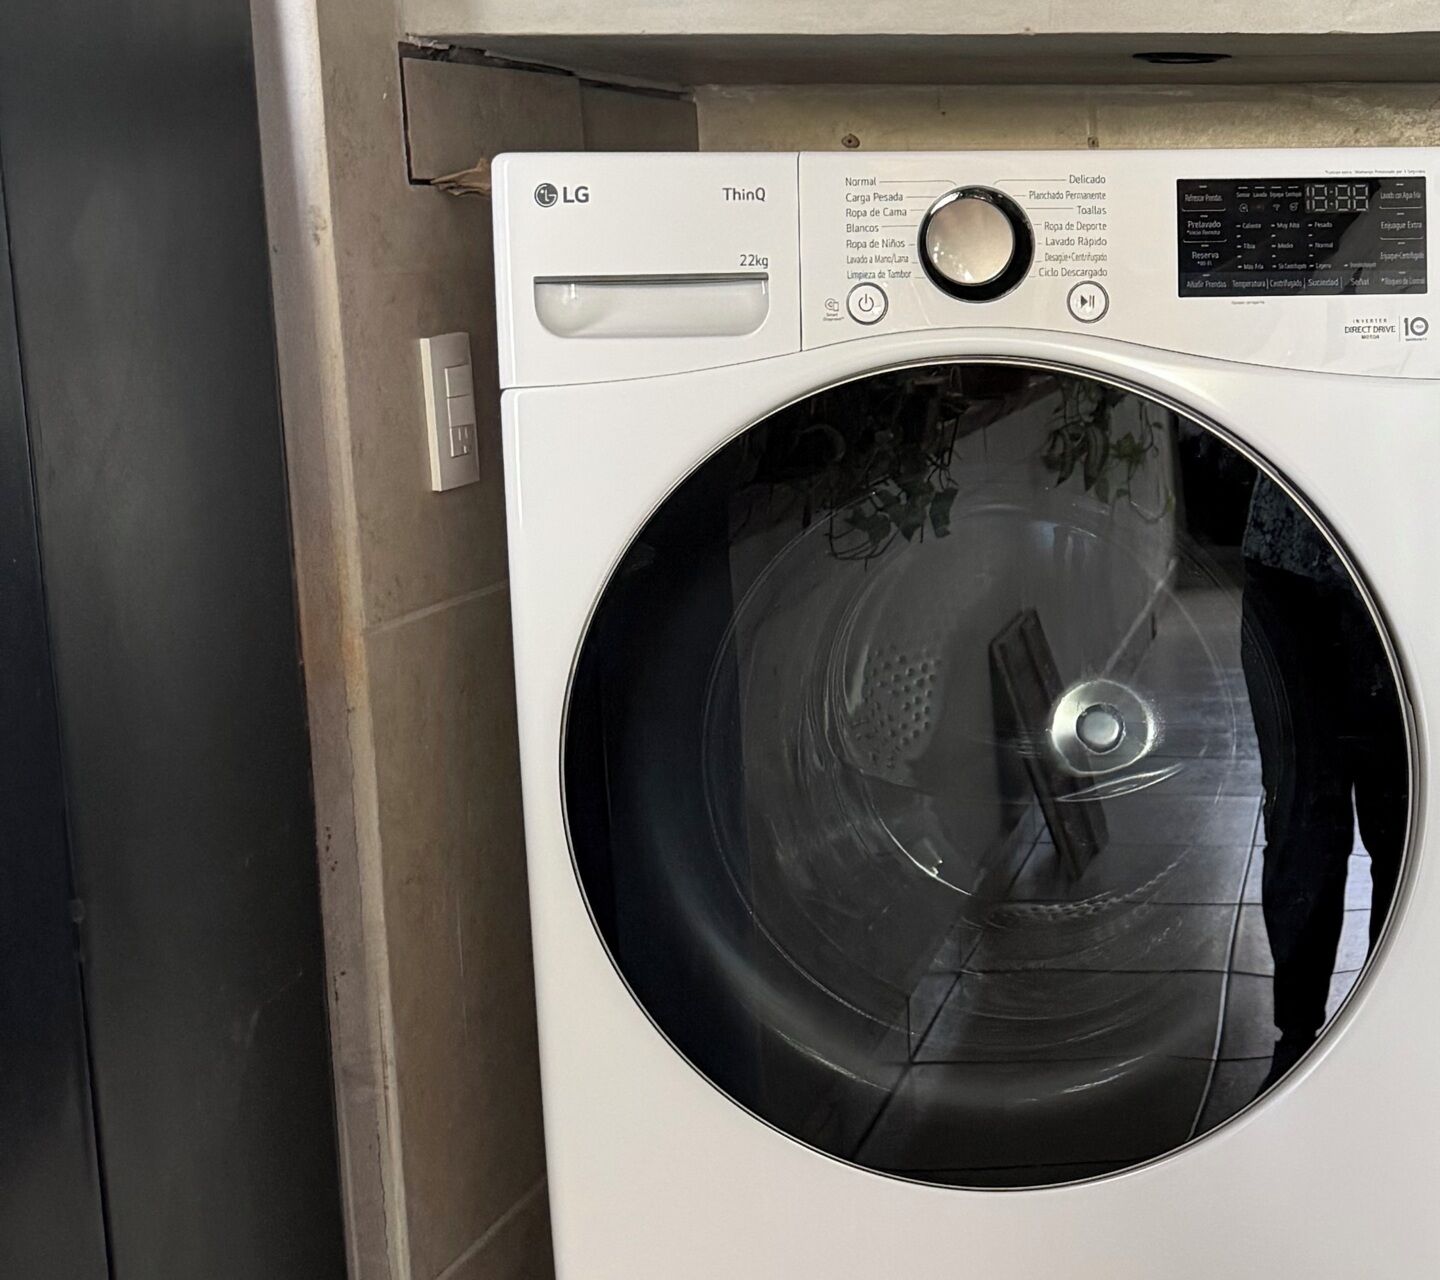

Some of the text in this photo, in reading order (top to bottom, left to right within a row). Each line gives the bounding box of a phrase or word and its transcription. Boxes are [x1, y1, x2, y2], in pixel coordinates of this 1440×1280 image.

[845, 177, 877, 186] Normal
[1069, 174, 1106, 184] Delicado
[563, 186, 590, 203] LG
[723, 186, 766, 202] ThinQ
[845, 192, 904, 204] Carga Pesada
[1029, 190, 1106, 200] Planchado Permanente
[845, 207, 907, 219] Ropa de Cama
[1077, 205, 1107, 215] Toallas
[846, 223, 880, 233] Blancos
[1044, 221, 1107, 232] Ropa de Deporte
[1187, 220, 1222, 229] Prelavado
[1380, 220, 1423, 231] Enjuague Extra
[846, 238, 906, 251] Ropa de Niños
[1045, 236, 1108, 248] Lavado Rápido
[846, 255, 868, 264] Lavado
[1191, 251, 1220, 259] Reserva
[740, 254, 769, 270] 22kg
[846, 269, 912, 280] Limpieza de Tambor
[1038, 267, 1108, 279] Ciclo Descargado
[1232, 279, 1266, 288] Temperatura
[1344, 325, 1396, 333] DIRECT DRIVE
[1403, 316, 1429, 337] 10
